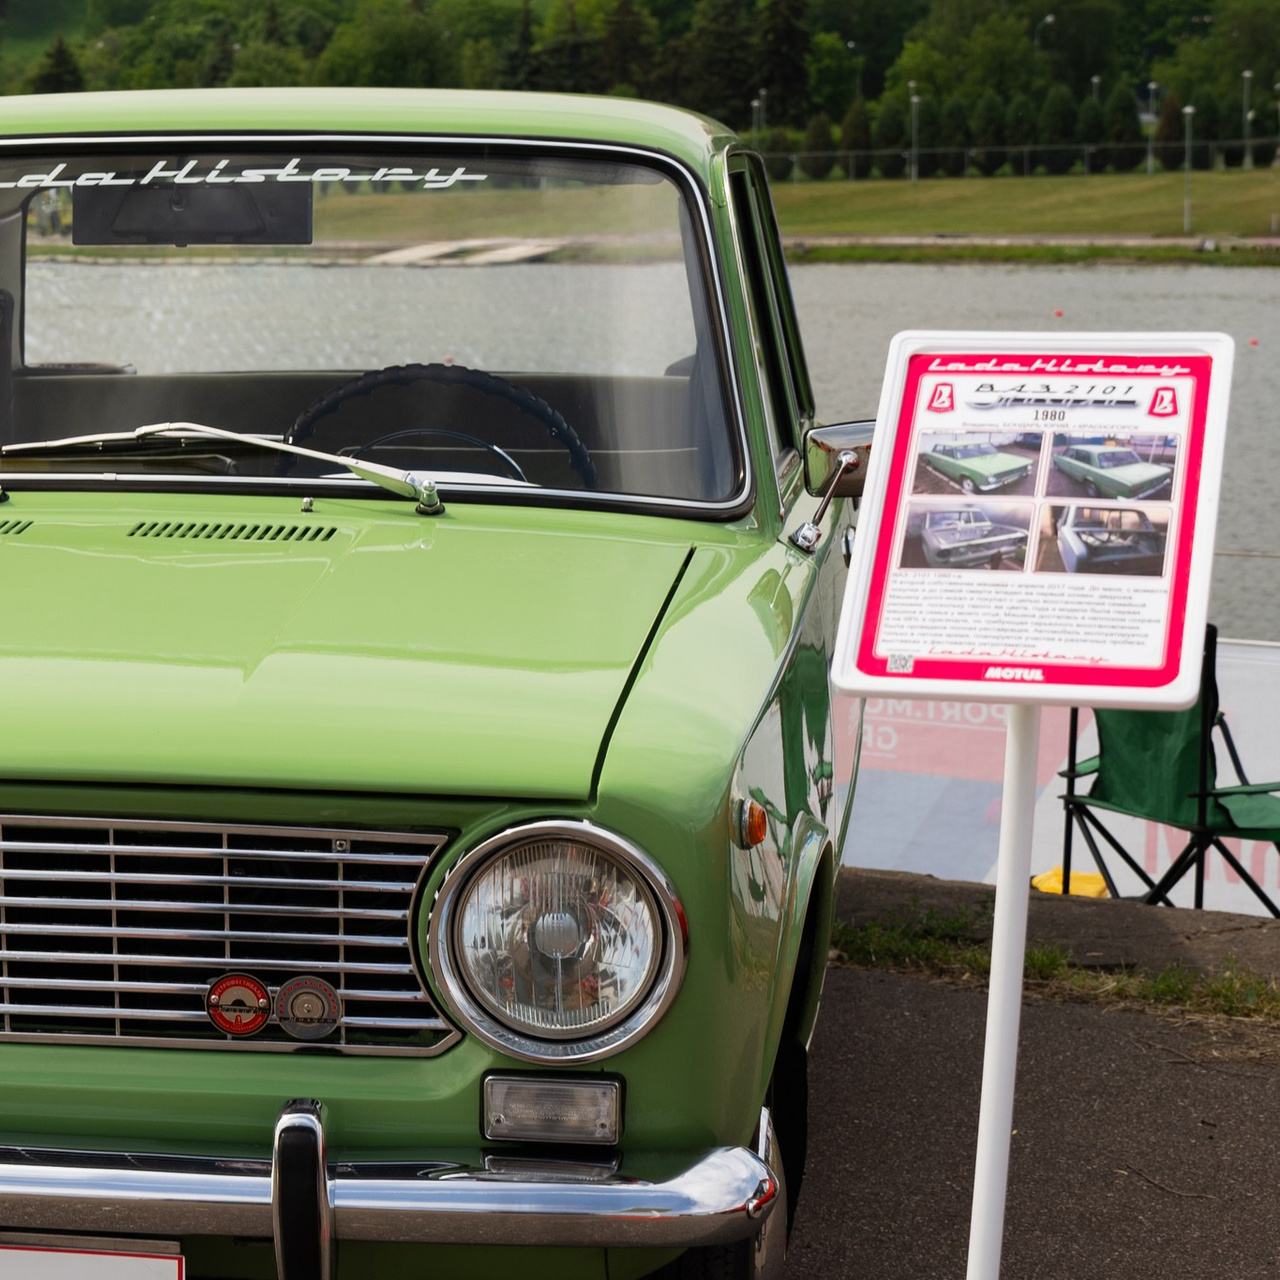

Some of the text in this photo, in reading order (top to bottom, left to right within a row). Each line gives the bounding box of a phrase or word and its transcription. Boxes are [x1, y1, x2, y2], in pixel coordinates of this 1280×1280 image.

[1065, 385, 1135, 396] 2101
[1033, 409, 1066, 422] 1980
[984, 666, 1044, 681] MOTUL
